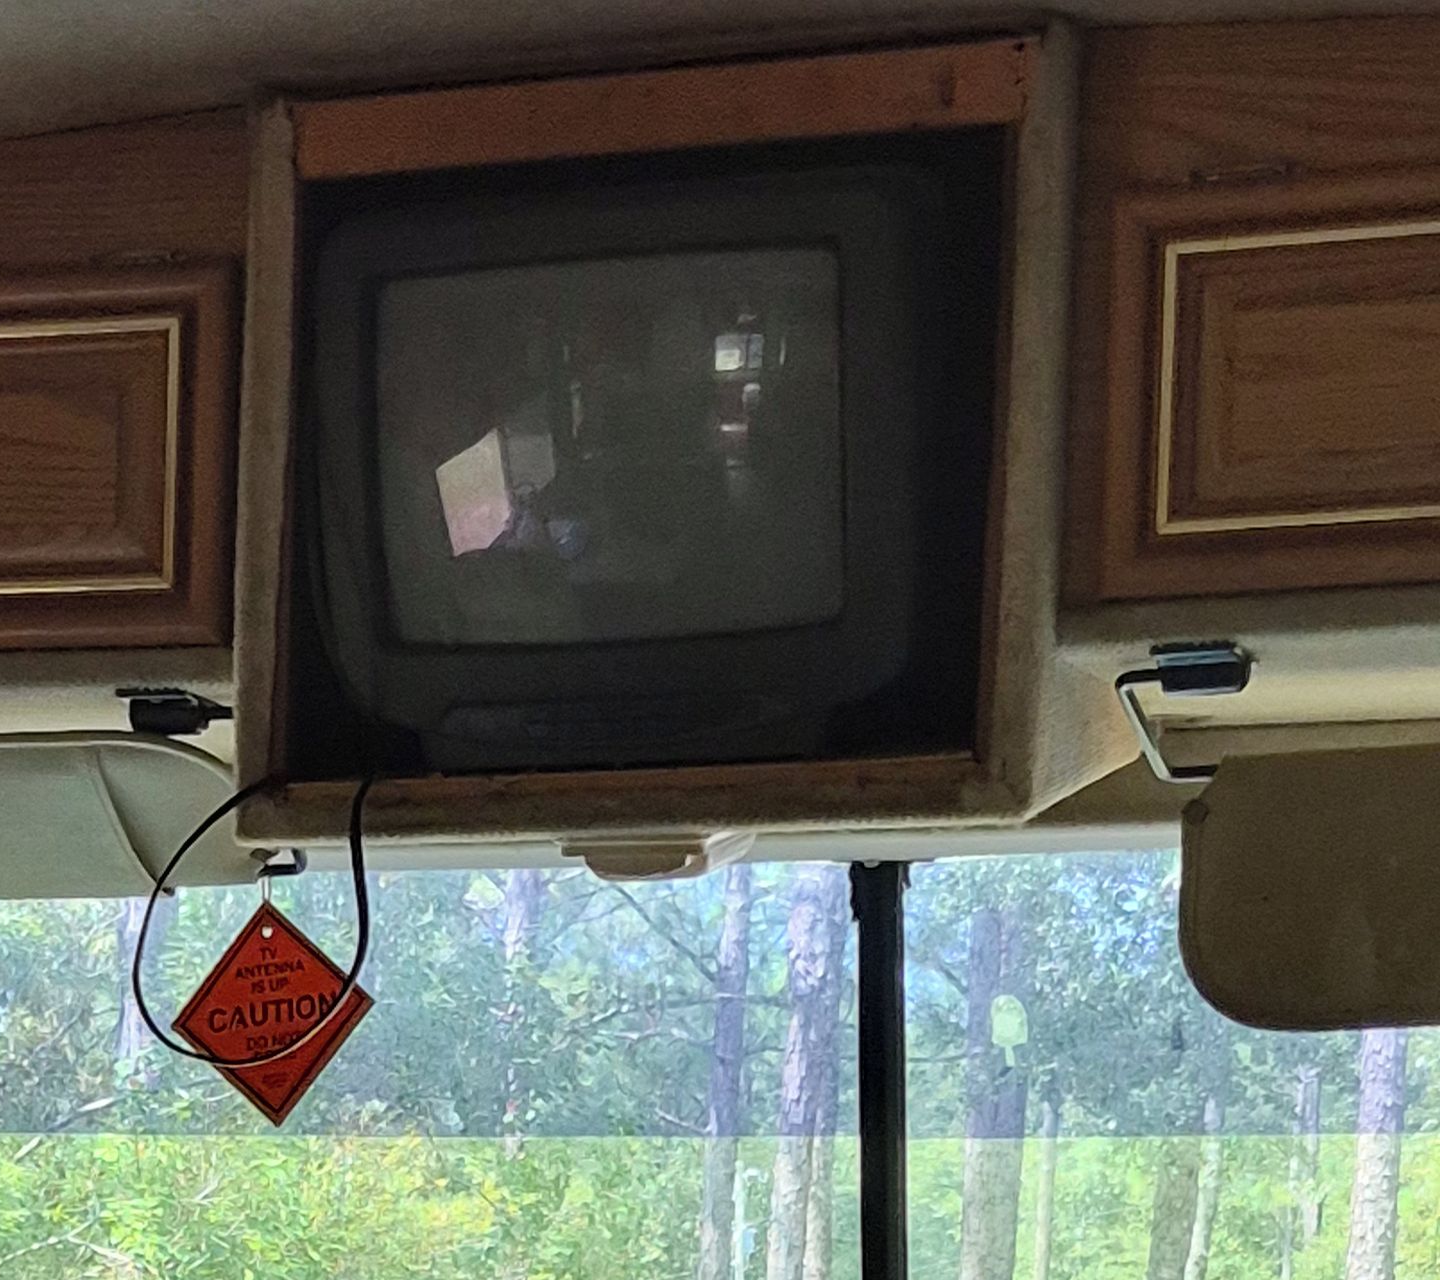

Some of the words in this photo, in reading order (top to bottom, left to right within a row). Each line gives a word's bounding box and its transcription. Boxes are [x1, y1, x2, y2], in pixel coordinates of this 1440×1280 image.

[260, 947, 277, 961] TV
[235, 959, 305, 978] ANTENNA
[251, 981, 266, 994] IS
[269, 977, 289, 992] UP
[208, 991, 338, 1033] CAUTION
[246, 1036, 269, 1051] DO
